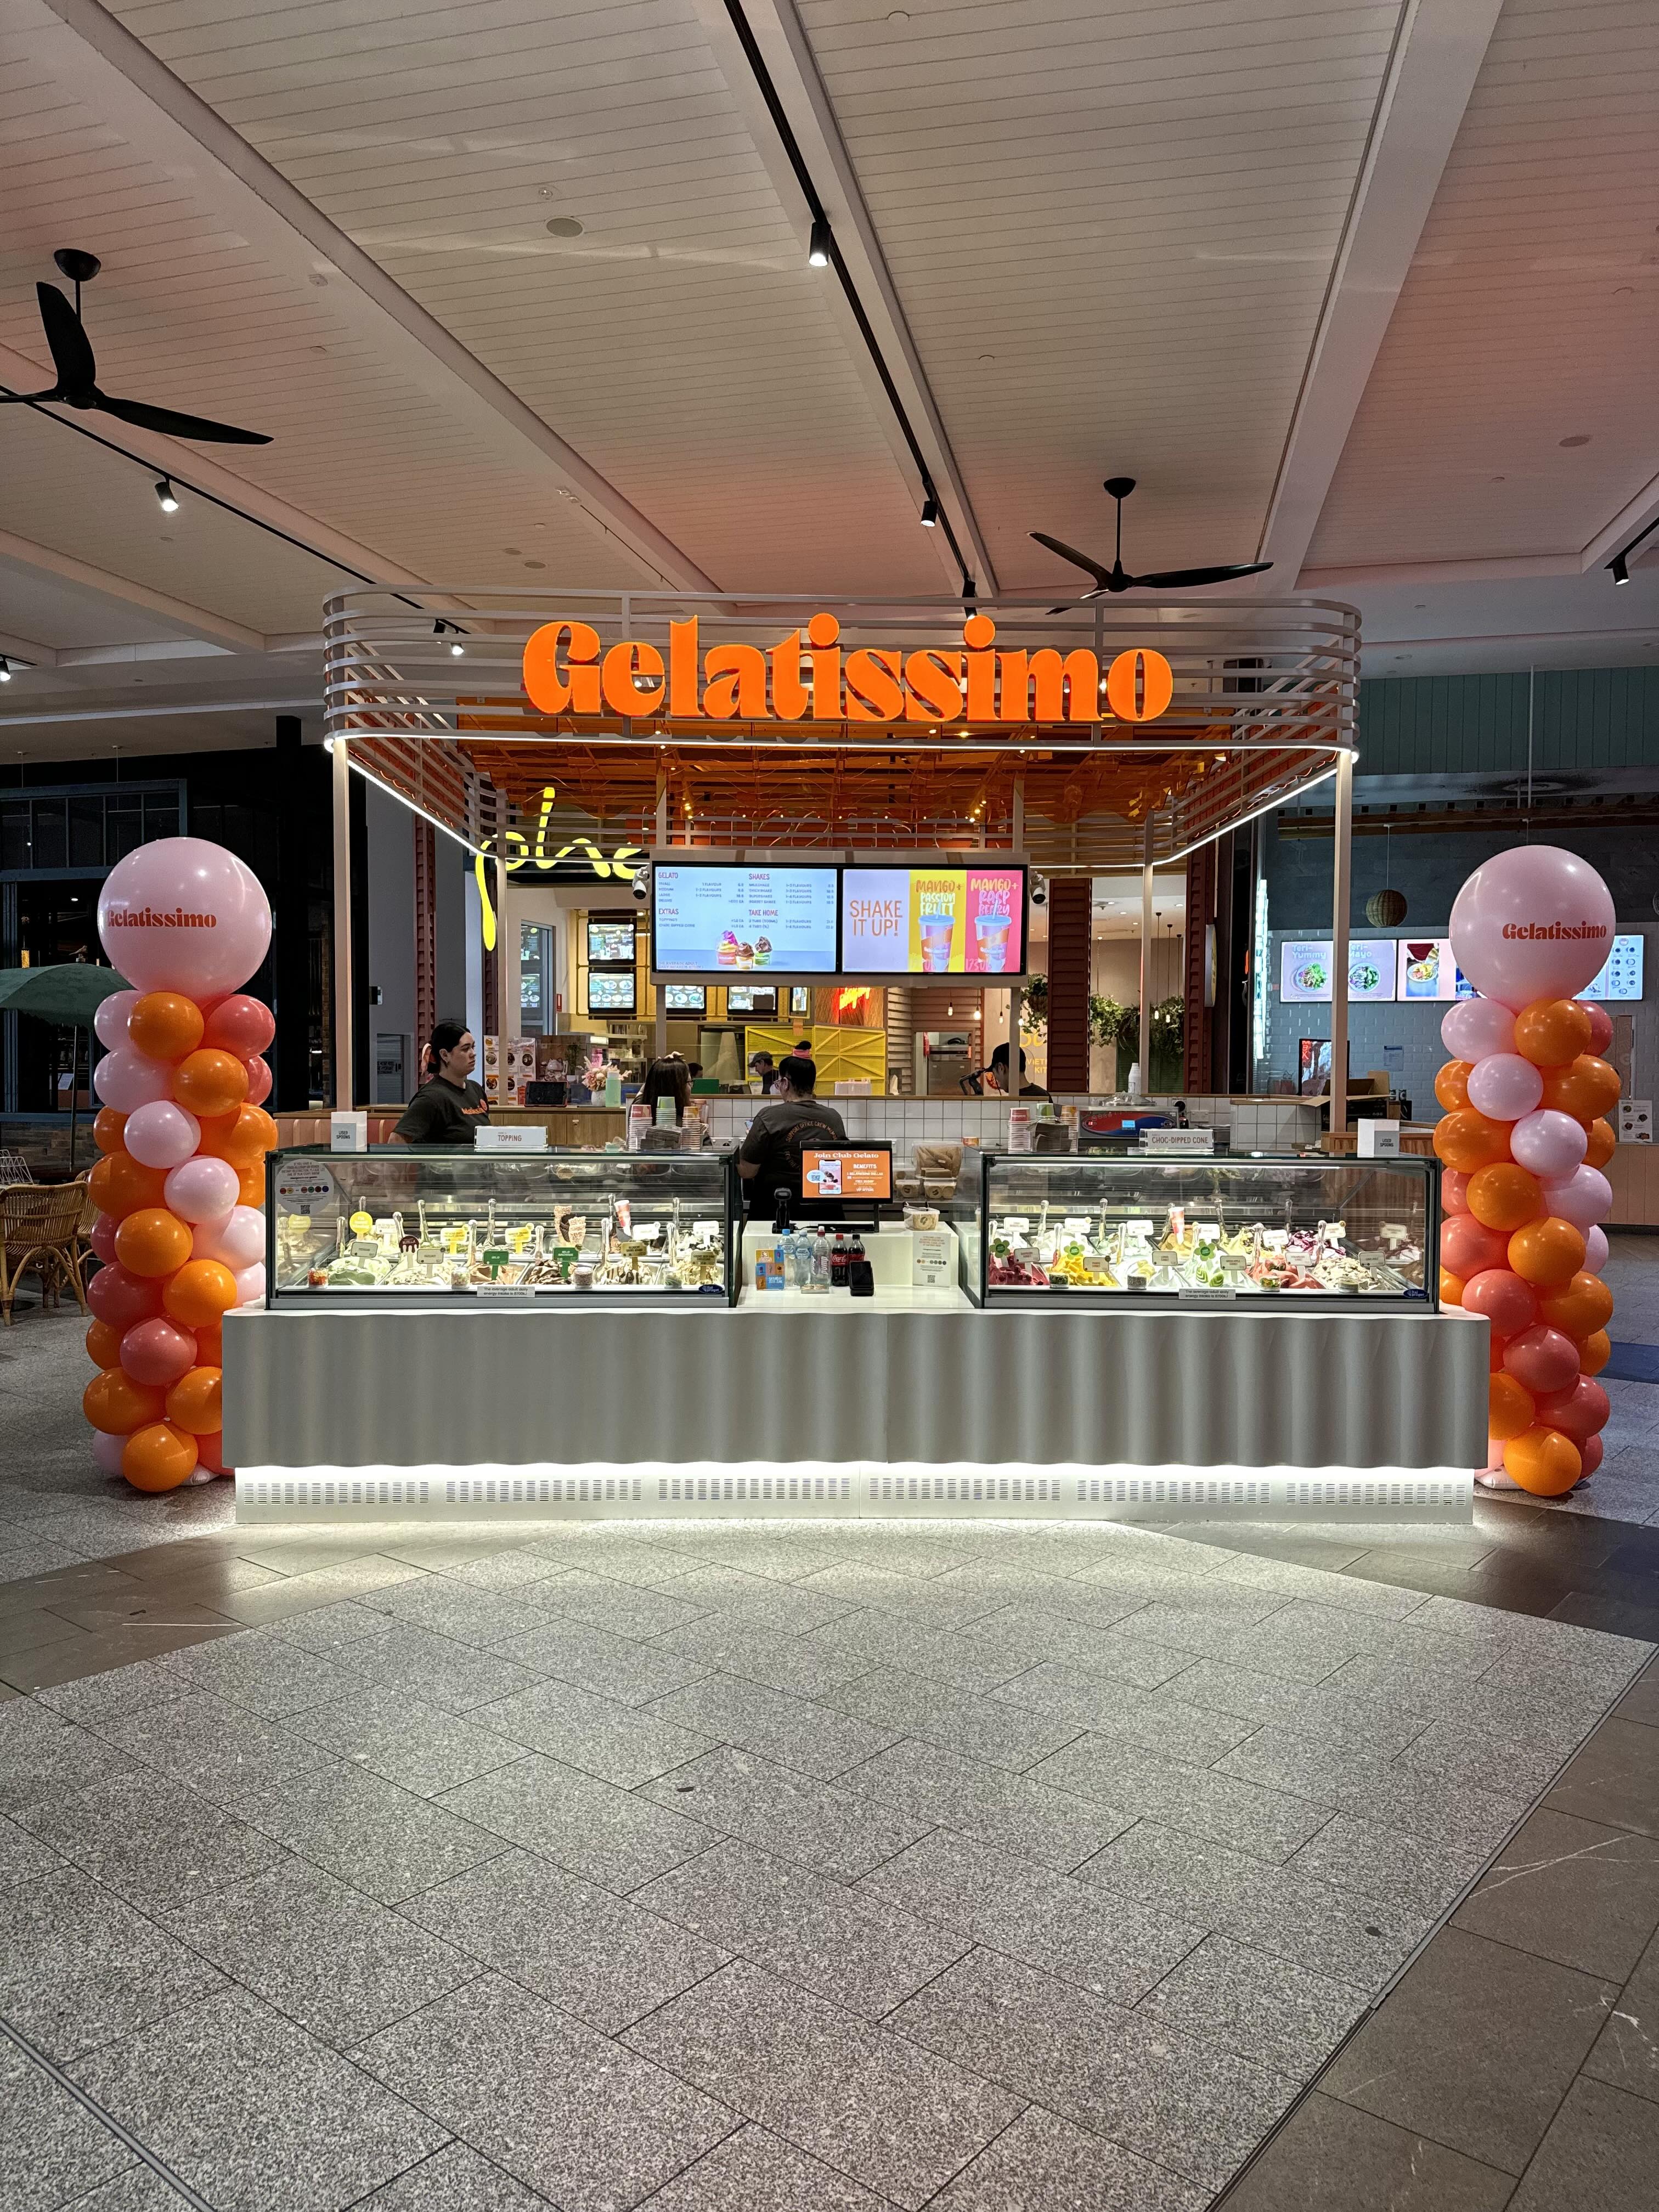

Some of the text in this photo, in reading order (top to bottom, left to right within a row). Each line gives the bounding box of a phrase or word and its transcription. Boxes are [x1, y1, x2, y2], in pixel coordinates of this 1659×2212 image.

[523, 613, 1173, 723] Gelatissimo
[920, 892, 956, 904] PASSION
[979, 890, 1010, 905] RASP
[850, 900, 902, 918] SHAKE
[853, 919, 898, 936] IT UP!
[1502, 921, 1607, 939] Gelatissimo
